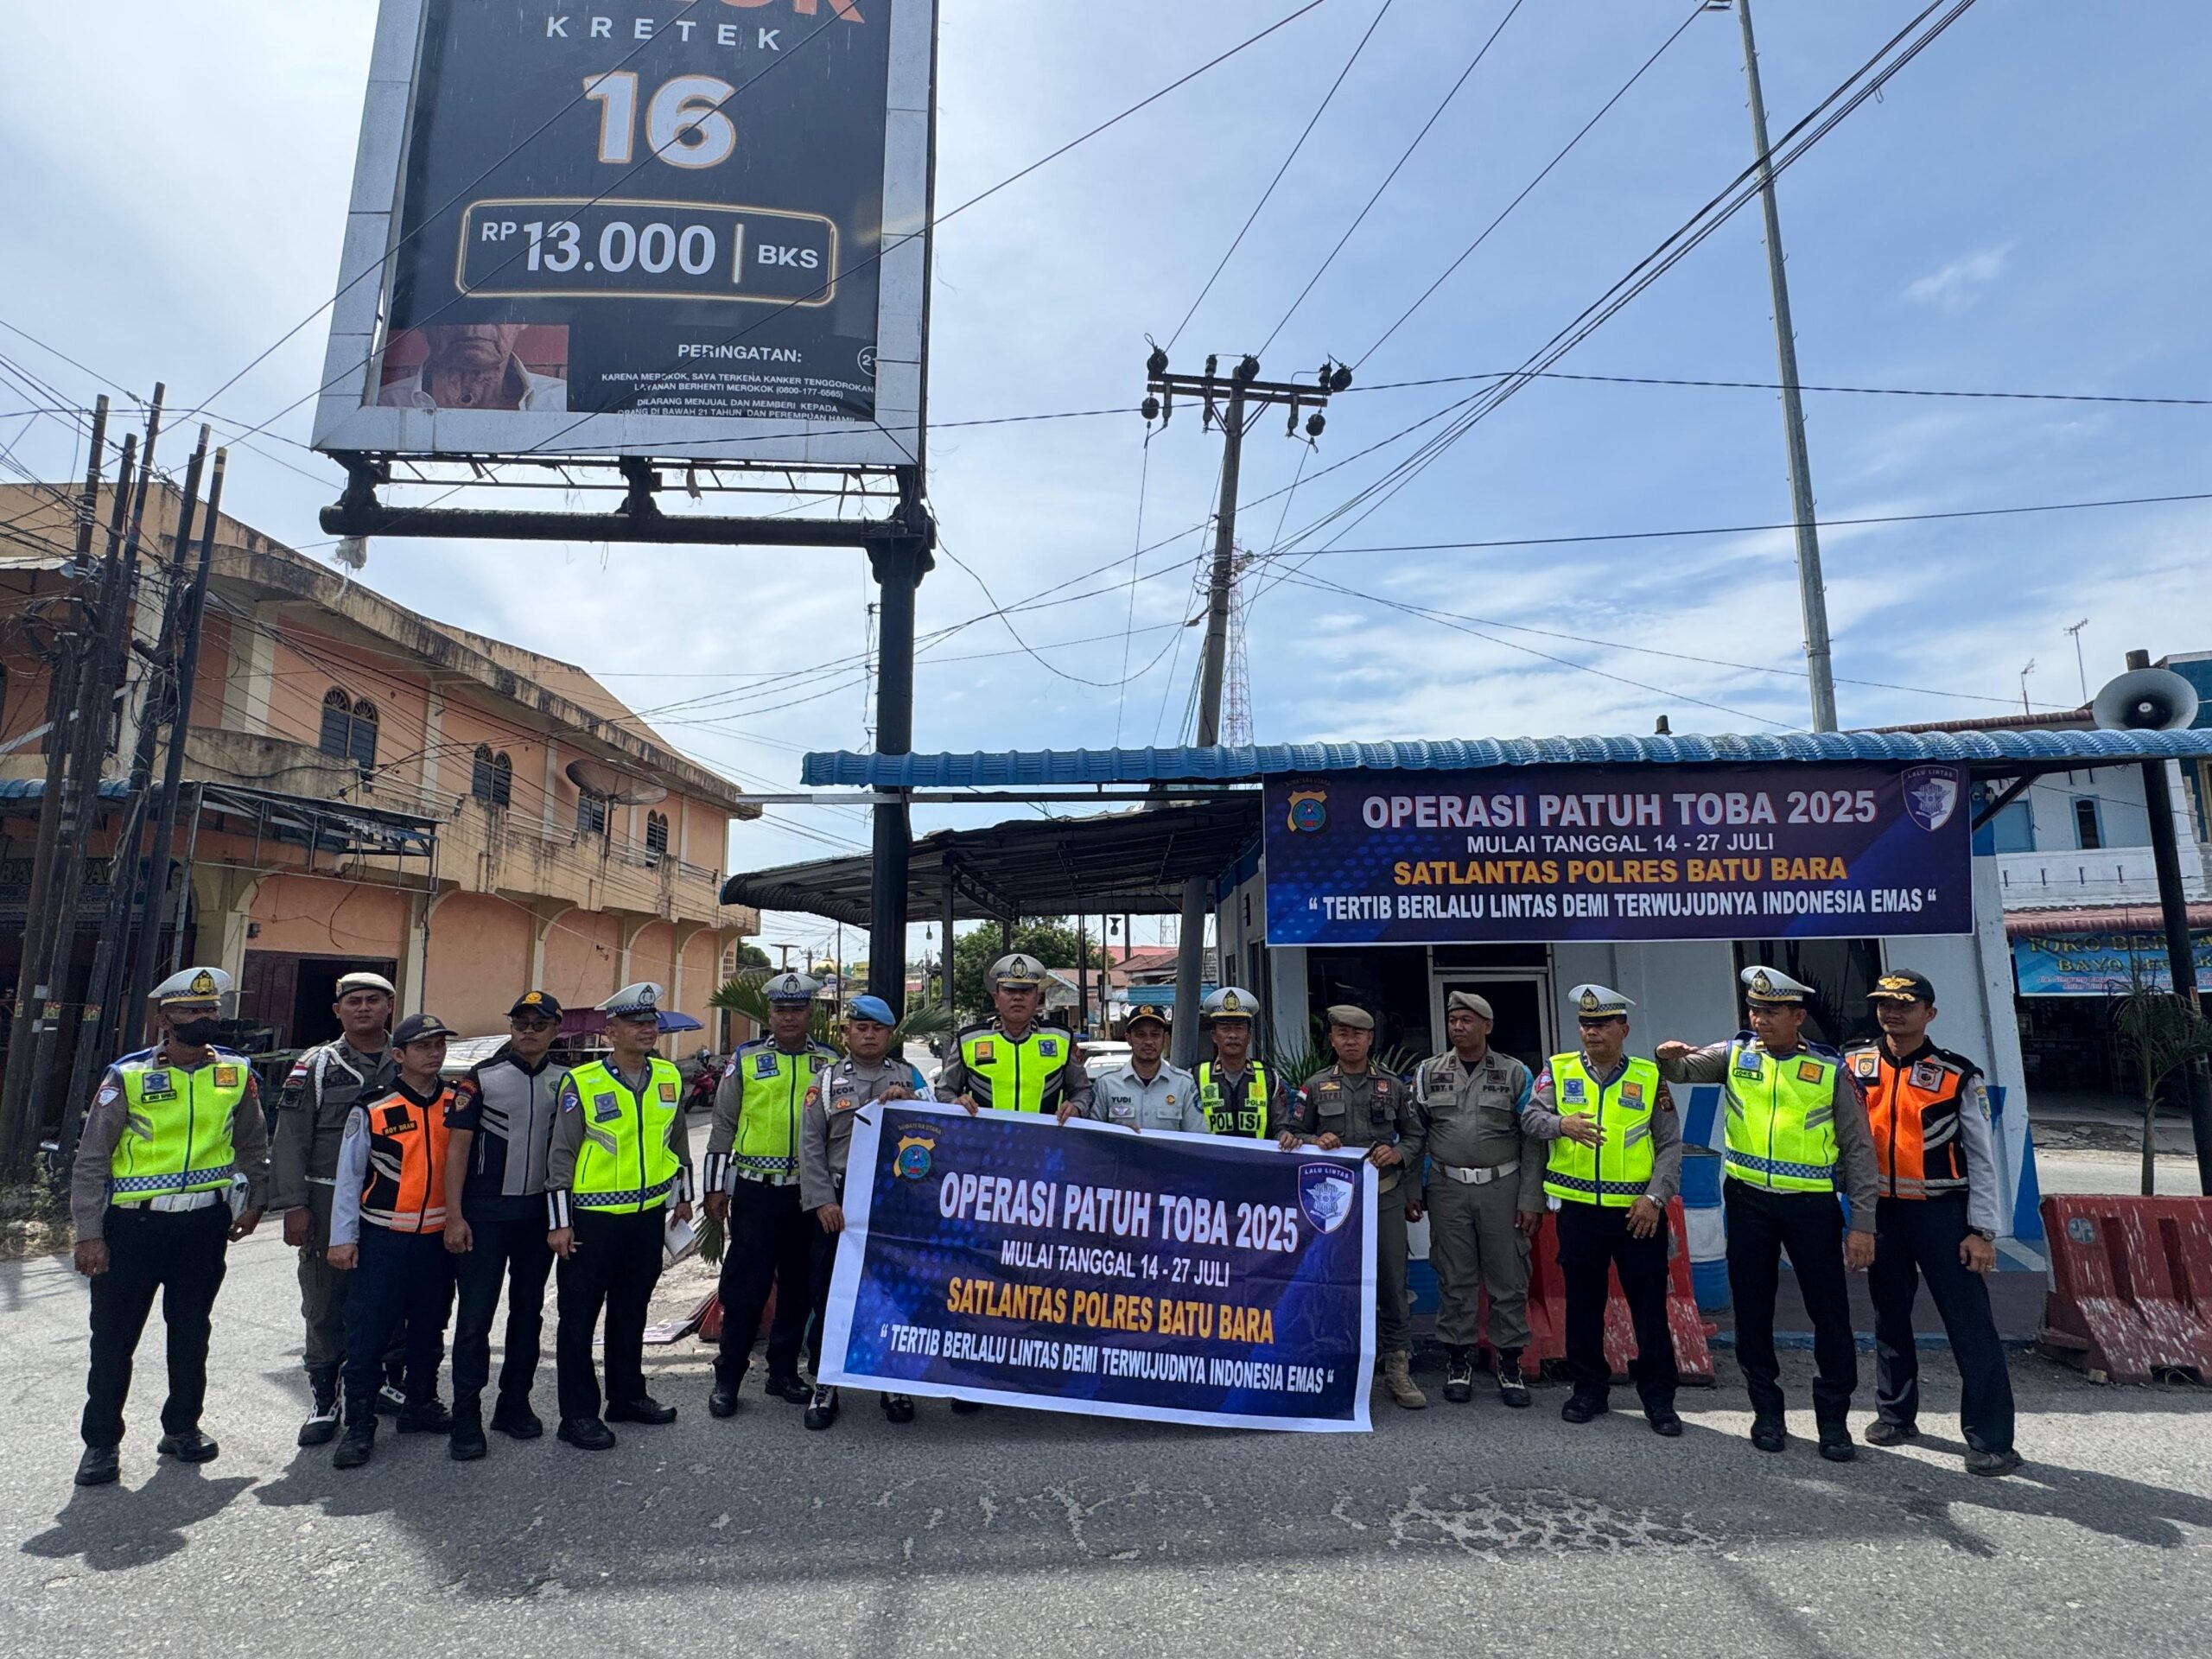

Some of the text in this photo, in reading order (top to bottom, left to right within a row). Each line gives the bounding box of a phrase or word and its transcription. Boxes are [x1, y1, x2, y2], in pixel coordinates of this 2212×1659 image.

[546, 16, 782, 51] KRETEK
[582, 70, 736, 168] 16
[481, 219, 819, 275] RP 13.000 BKS
[677, 345, 802, 363] PERINGATAN:
[718, 374, 761, 383] TERKENA
[763, 375, 801, 385] KANKER
[726, 385, 773, 393] MEROKOK
[637, 397, 838, 412] DILARANG MENJUAL DAN MEMBERI KEPADA
[1362, 791, 1878, 829] OPERASI PATUH TOBA 2025
[1466, 835, 1535, 854] MULAI
[1541, 835, 1647, 854] TANGGAL
[1653, 835, 1677, 852] 14
[1697, 834, 1720, 852] 27
[1726, 833, 1775, 851] JULI
[1394, 857, 1848, 886] SATLANTAS POLRES BATU BARA
[1323, 895, 1394, 920] TERTIB
[1397, 895, 1484, 919] BERLALU
[1491, 894, 1558, 918] LINTAS
[1562, 894, 1609, 918] DEMI
[1614, 892, 1758, 918] TERWUJUDNYA
[1762, 891, 1866, 916] INDONESIA
[1871, 889, 1923, 914] EMAS
[2031, 938, 2101, 952] TOKO
[1325, 1168, 1349, 1179] LINTAS
[939, 1173, 1298, 1253] OPERASI PATUH TOBA 2025
[1001, 1240, 1054, 1269] MULAI
[1058, 1246, 1136, 1280] TANGGAL
[1141, 1255, 1159, 1281] 14
[1172, 1257, 1190, 1283] 27
[1195, 1260, 1230, 1287] JULI
[947, 1277, 1274, 1344] SATLANTAS POLRES BATU BARA
[891, 1324, 941, 1357] TERTIB
[944, 1330, 1007, 1364] BERLALU
[1008, 1338, 1058, 1370] LINTAS
[1062, 1344, 1097, 1373] DEMI
[1101, 1349, 1205, 1384] TERWUJUDNYA
[1210, 1358, 1283, 1390] INDONESIA
[1288, 1366, 1325, 1393] EMAS
